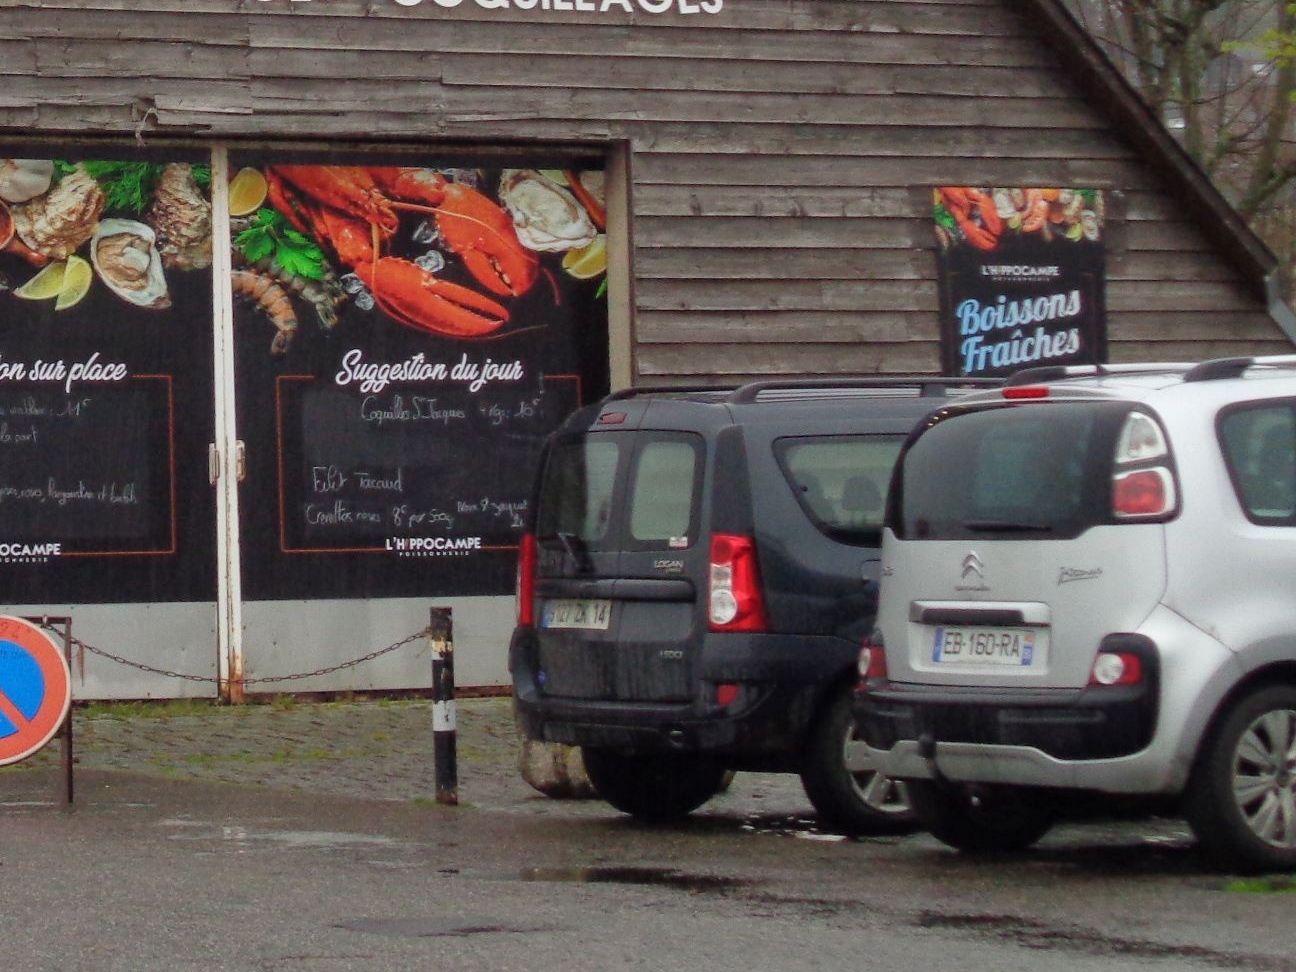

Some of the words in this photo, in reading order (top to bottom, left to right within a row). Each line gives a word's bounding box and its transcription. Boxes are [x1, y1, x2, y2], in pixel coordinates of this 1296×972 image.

[956, 289, 1081, 336] Boissons
[29, 360, 66, 382] sur
[66, 352, 127, 393] place
[335, 349, 445, 393] Suggestion
[450, 352, 478, 382] du
[474, 358, 524, 393] jour
[961, 327, 1081, 373] Fraîches
